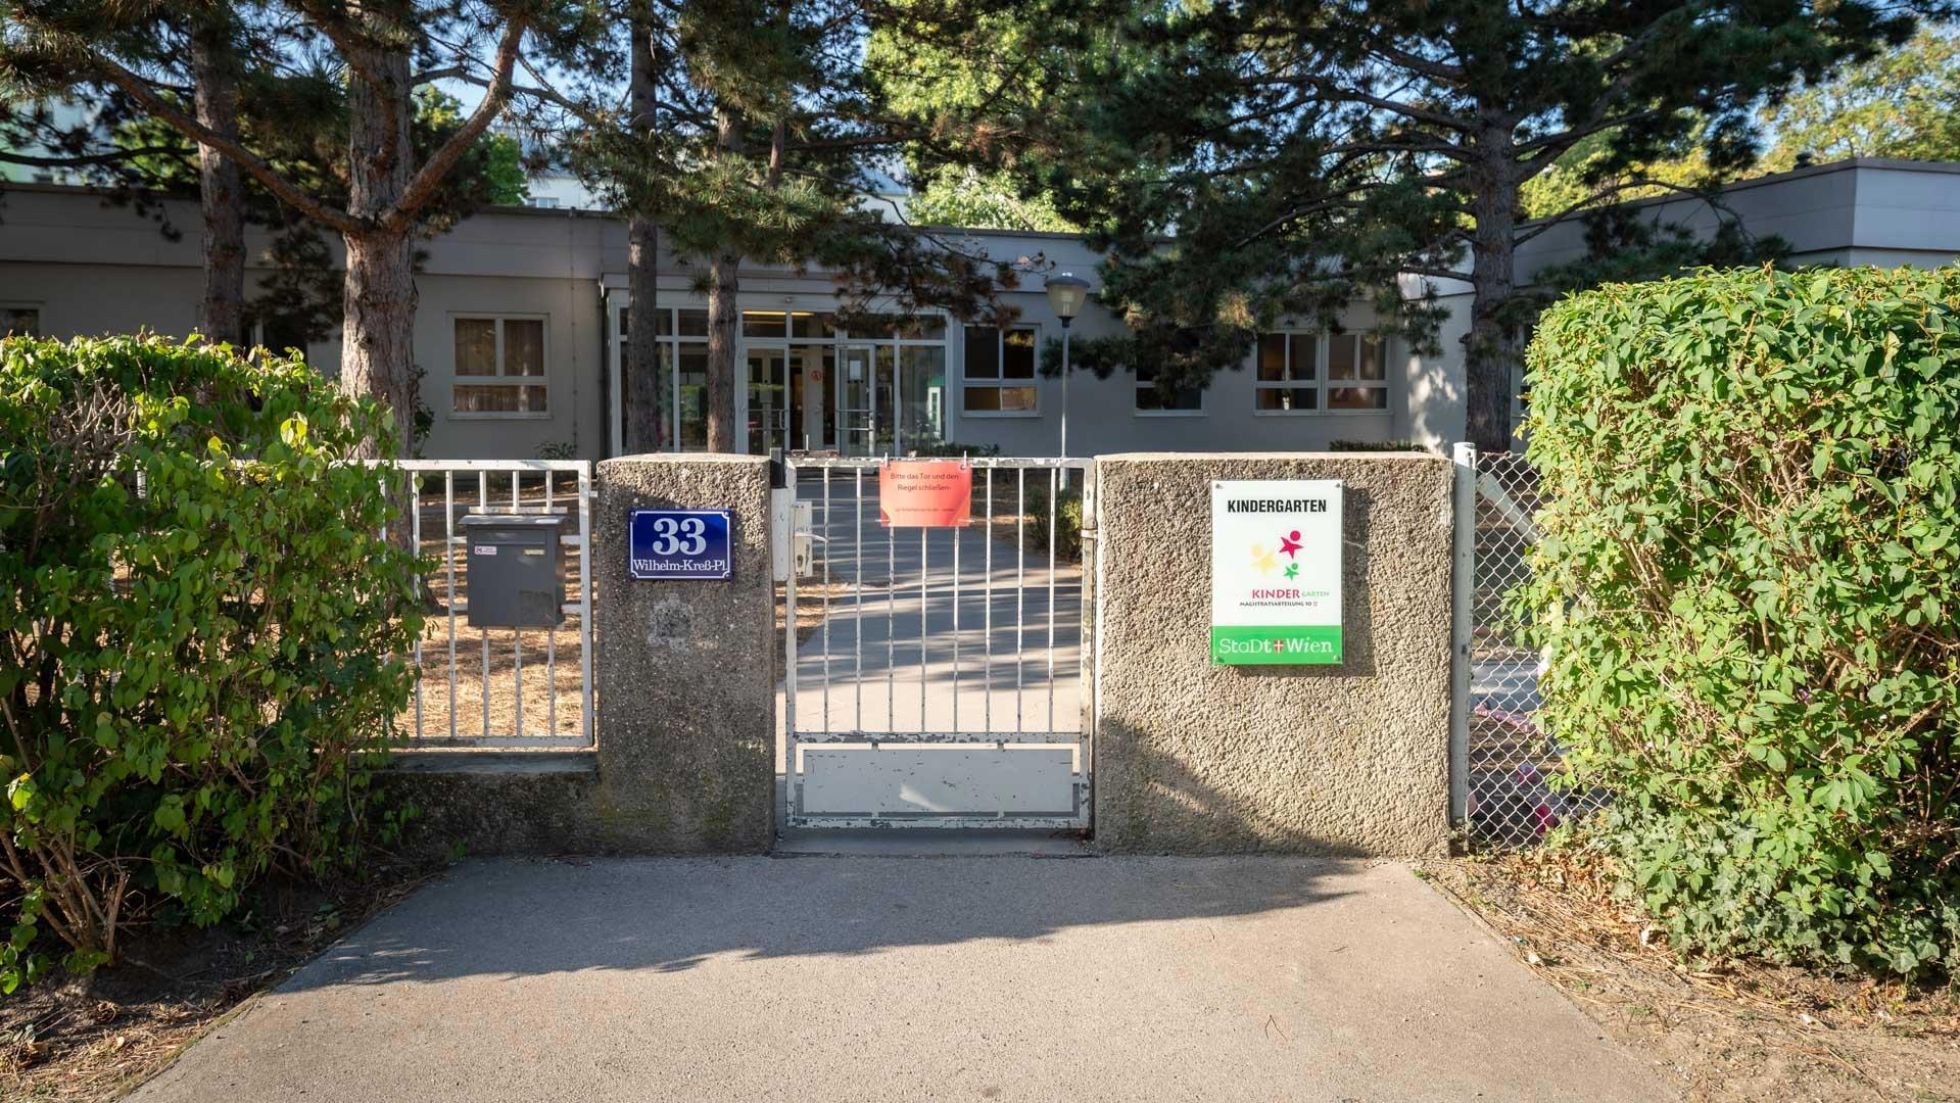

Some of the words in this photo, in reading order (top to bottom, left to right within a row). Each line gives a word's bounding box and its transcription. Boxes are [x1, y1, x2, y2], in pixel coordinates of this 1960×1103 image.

[897, 484, 918, 492] Riegel
[1227, 499, 1327, 513] KINDERGARTEN
[652, 517, 707, 556] 33
[1252, 589, 1301, 599] KINDER
[1286, 637, 1333, 654] Wien
